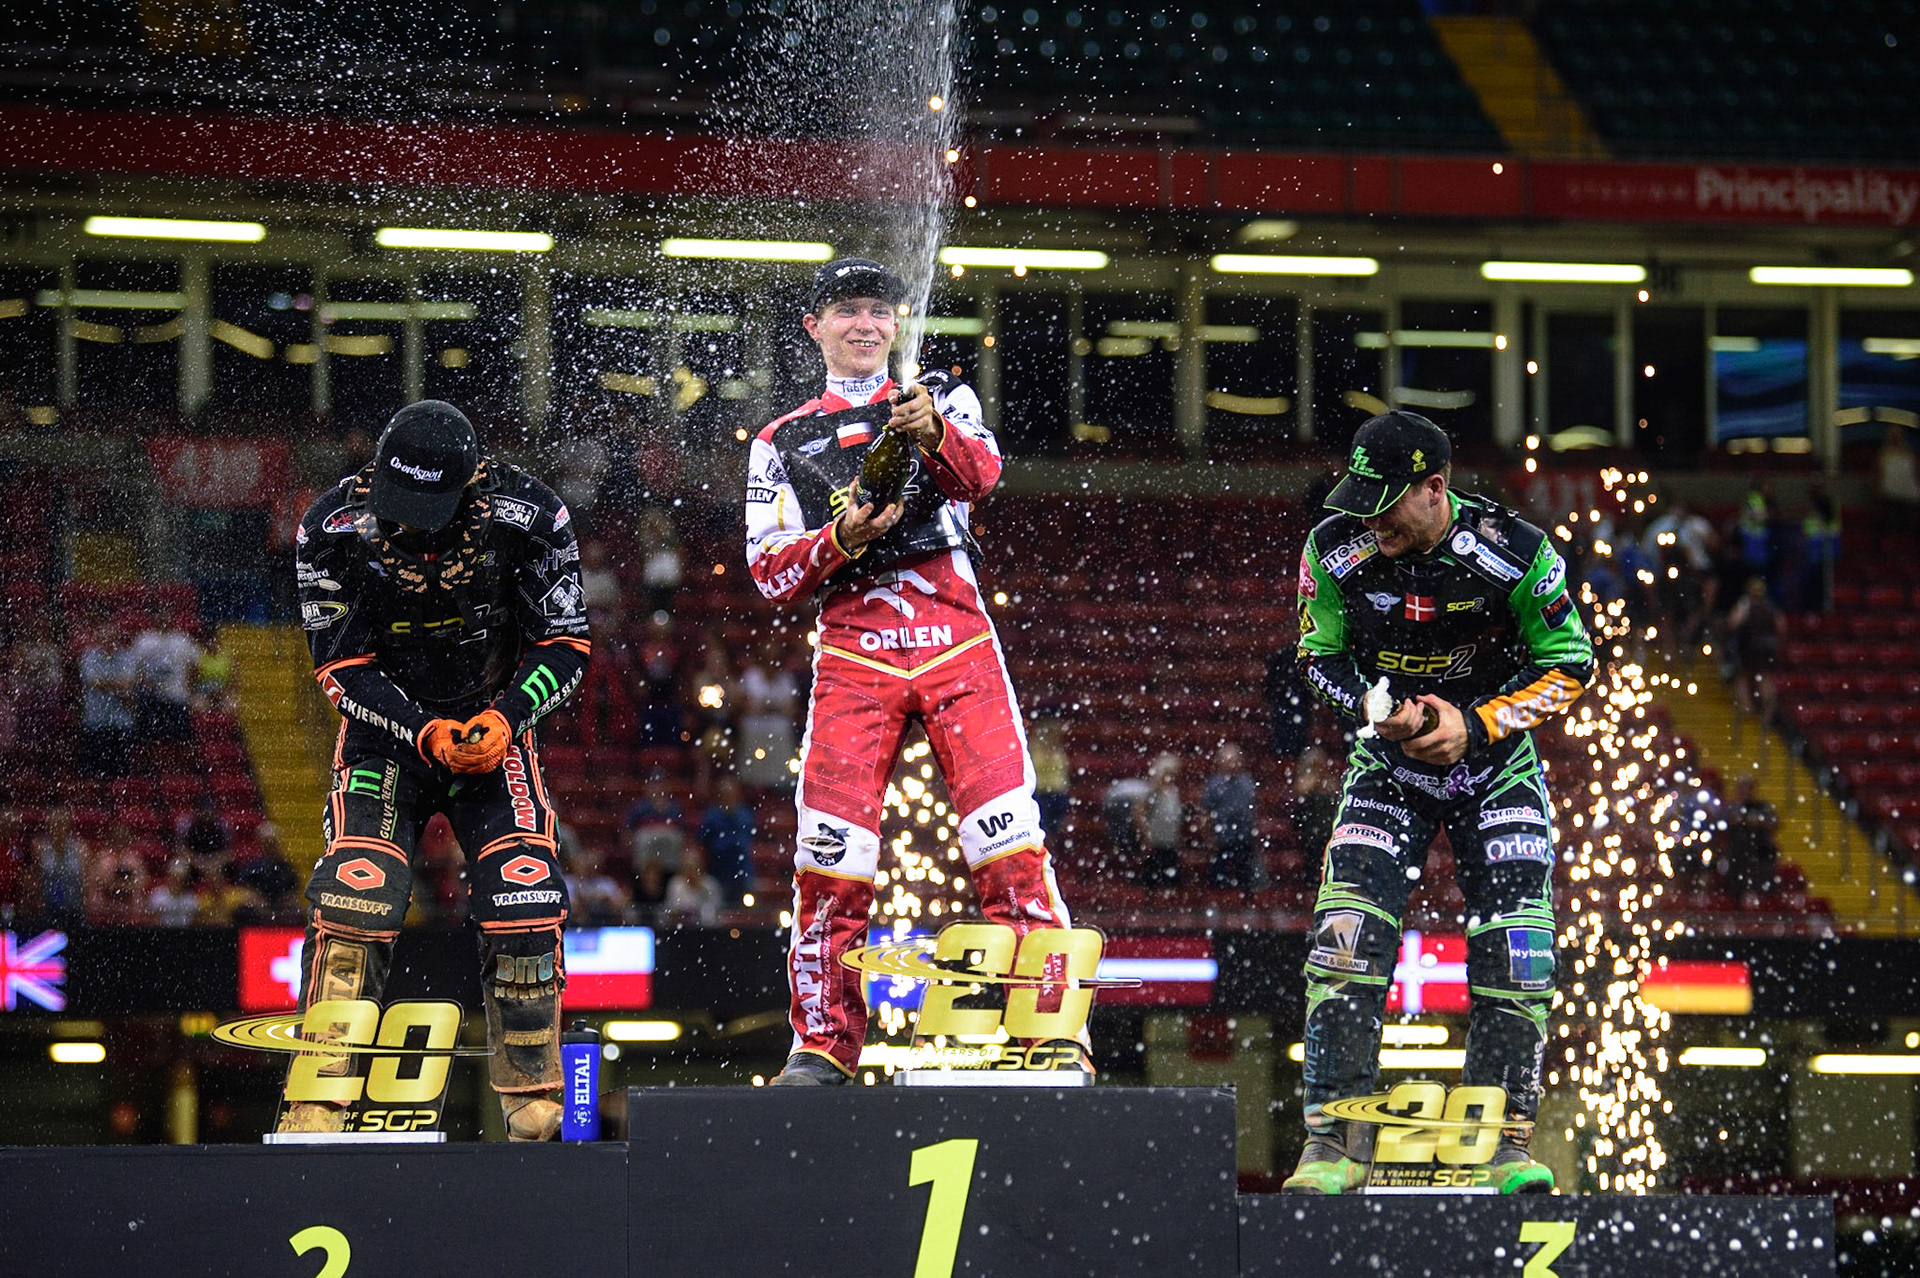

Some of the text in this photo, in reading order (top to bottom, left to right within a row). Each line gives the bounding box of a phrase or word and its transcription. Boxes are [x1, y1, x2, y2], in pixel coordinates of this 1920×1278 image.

[1696, 167, 1918, 225] Principality
[494, 499, 526, 513] NIKKEL
[746, 489, 773, 502] RLEN
[495, 507, 531, 525] ROM
[756, 562, 805, 599] RLEN
[1446, 597, 1485, 612] SGP2
[859, 625, 952, 651] ORLEN
[1376, 644, 1477, 680] SGP2
[520, 664, 559, 711] JTI
[341, 695, 388, 730] SKJERN
[1482, 808, 1540, 821] TermoGo
[1346, 827, 1388, 843] BYGMA
[1486, 834, 1548, 860] Orloff
[321, 893, 387, 915] TRANSLYFT
[493, 891, 561, 906] TRANSLYFT
[1337, 959, 1367, 970] GRANIT
[1510, 948, 1552, 959] Nybol
[496, 952, 554, 984] BITO
[914, 924, 1104, 1038] 20
[284, 999, 463, 1102] 20
[996, 1047, 1081, 1070] SGP
[575, 1054, 590, 1105] ELTAL
[281, 1111, 298, 1120] 20
[342, 1111, 359, 1120] OF
[359, 1110, 438, 1132] SGP
[1374, 1083, 1507, 1164] 20
[1373, 1170, 1432, 1178] 20 YEARS OF
[1432, 1169, 1491, 1187] SGP
[909, 1139, 979, 1278] 1
